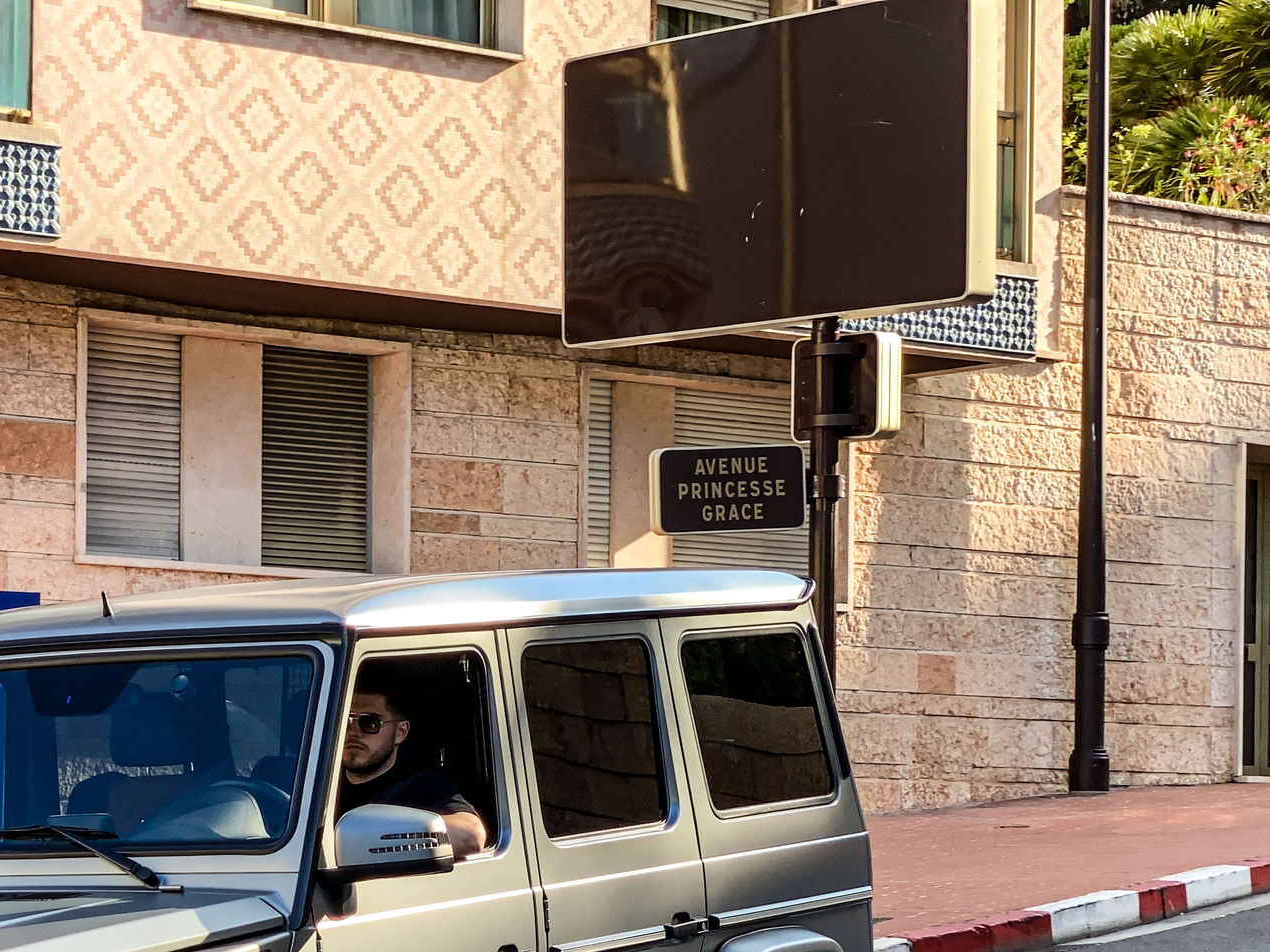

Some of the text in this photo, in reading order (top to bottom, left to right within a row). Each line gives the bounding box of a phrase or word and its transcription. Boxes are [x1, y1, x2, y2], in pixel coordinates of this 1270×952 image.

[695, 457, 768, 476] AVENUE
[678, 479, 786, 500] PRINCESSE
[702, 503, 764, 522] GRACE
